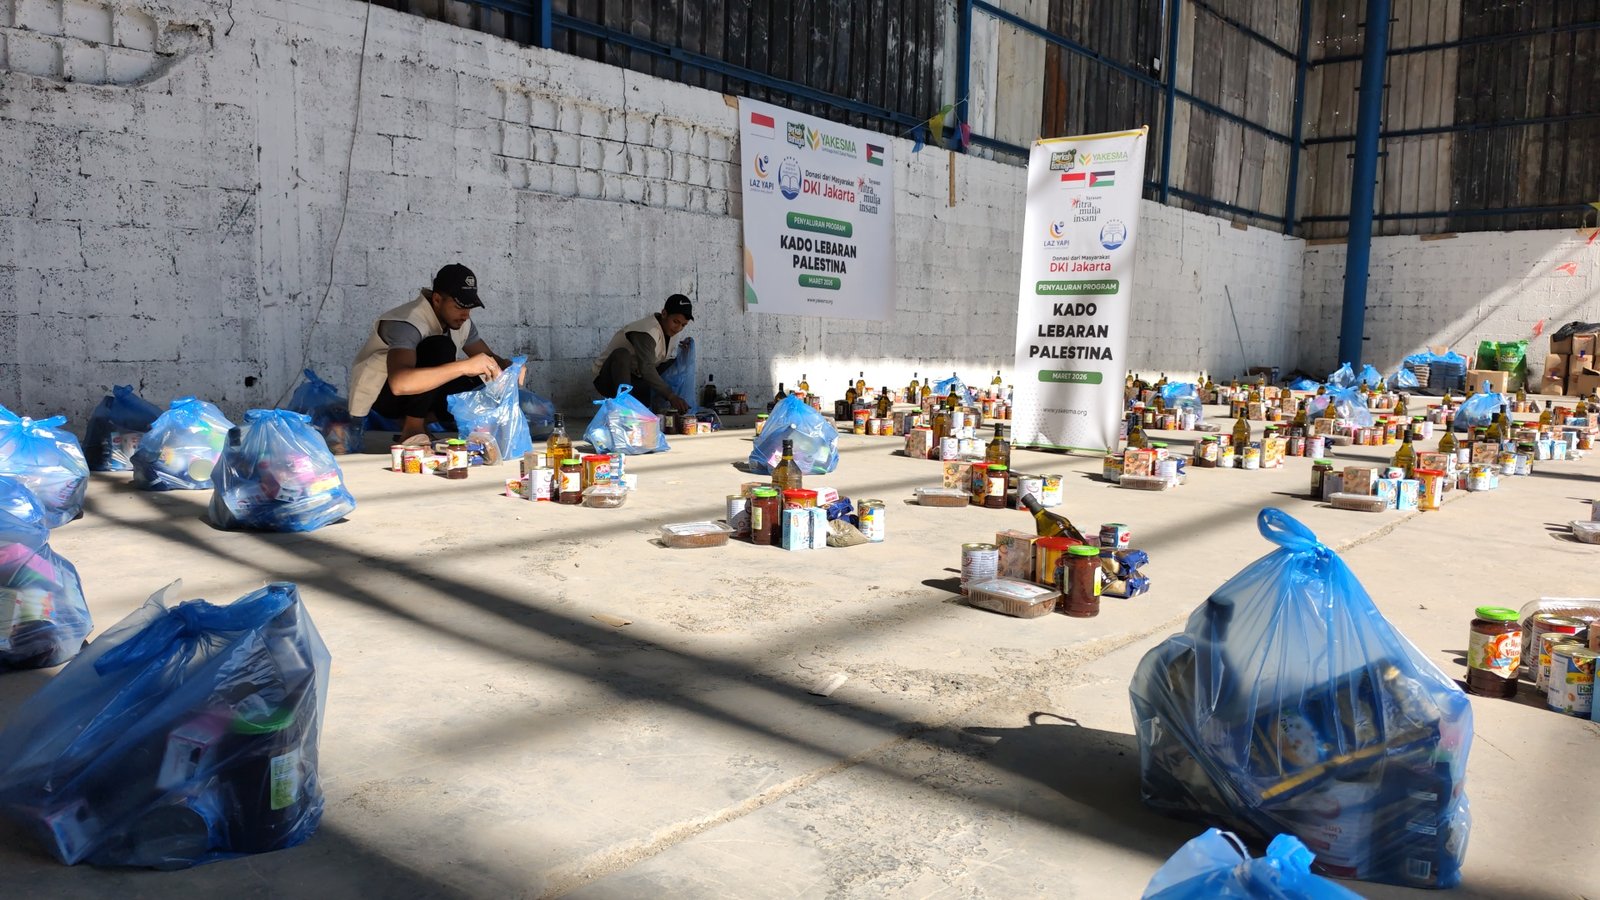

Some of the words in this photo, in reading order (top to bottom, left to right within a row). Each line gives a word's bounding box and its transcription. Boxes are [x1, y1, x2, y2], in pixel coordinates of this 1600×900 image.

[820, 132, 857, 154] YAKESMA
[1092, 151, 1128, 161] YAKESMA
[749, 178, 760, 188] LAZ
[763, 181, 775, 190] YAPI
[805, 169, 822, 181] Donasi
[822, 173, 831, 182] dari
[831, 176, 855, 187] Masyarakat
[803, 179, 821, 196] DKI
[823, 182, 855, 203] Jakarta
[859, 201, 878, 215] insani
[794, 216, 826, 228] PENYALURAN
[826, 221, 846, 232] PROGRAM
[1073, 214, 1097, 222] insani
[780, 235, 812, 251] KADO
[815, 240, 857, 258] LEBARAN
[793, 255, 847, 274] PALESTINA
[1050, 262, 1068, 272] DKI
[1071, 261, 1111, 272] Jakarta
[808, 277, 823, 285] MARET
[1082, 283, 1117, 291] PROGRAM
[1053, 303, 1097, 317] KADO
[1038, 324, 1109, 338] LEBARAN
[1029, 345, 1113, 361] PALESTINA
[1052, 372, 1072, 380] MARET
[1072, 373, 1088, 381] 2026
[1043, 407, 1088, 417] www.yakesma.org
